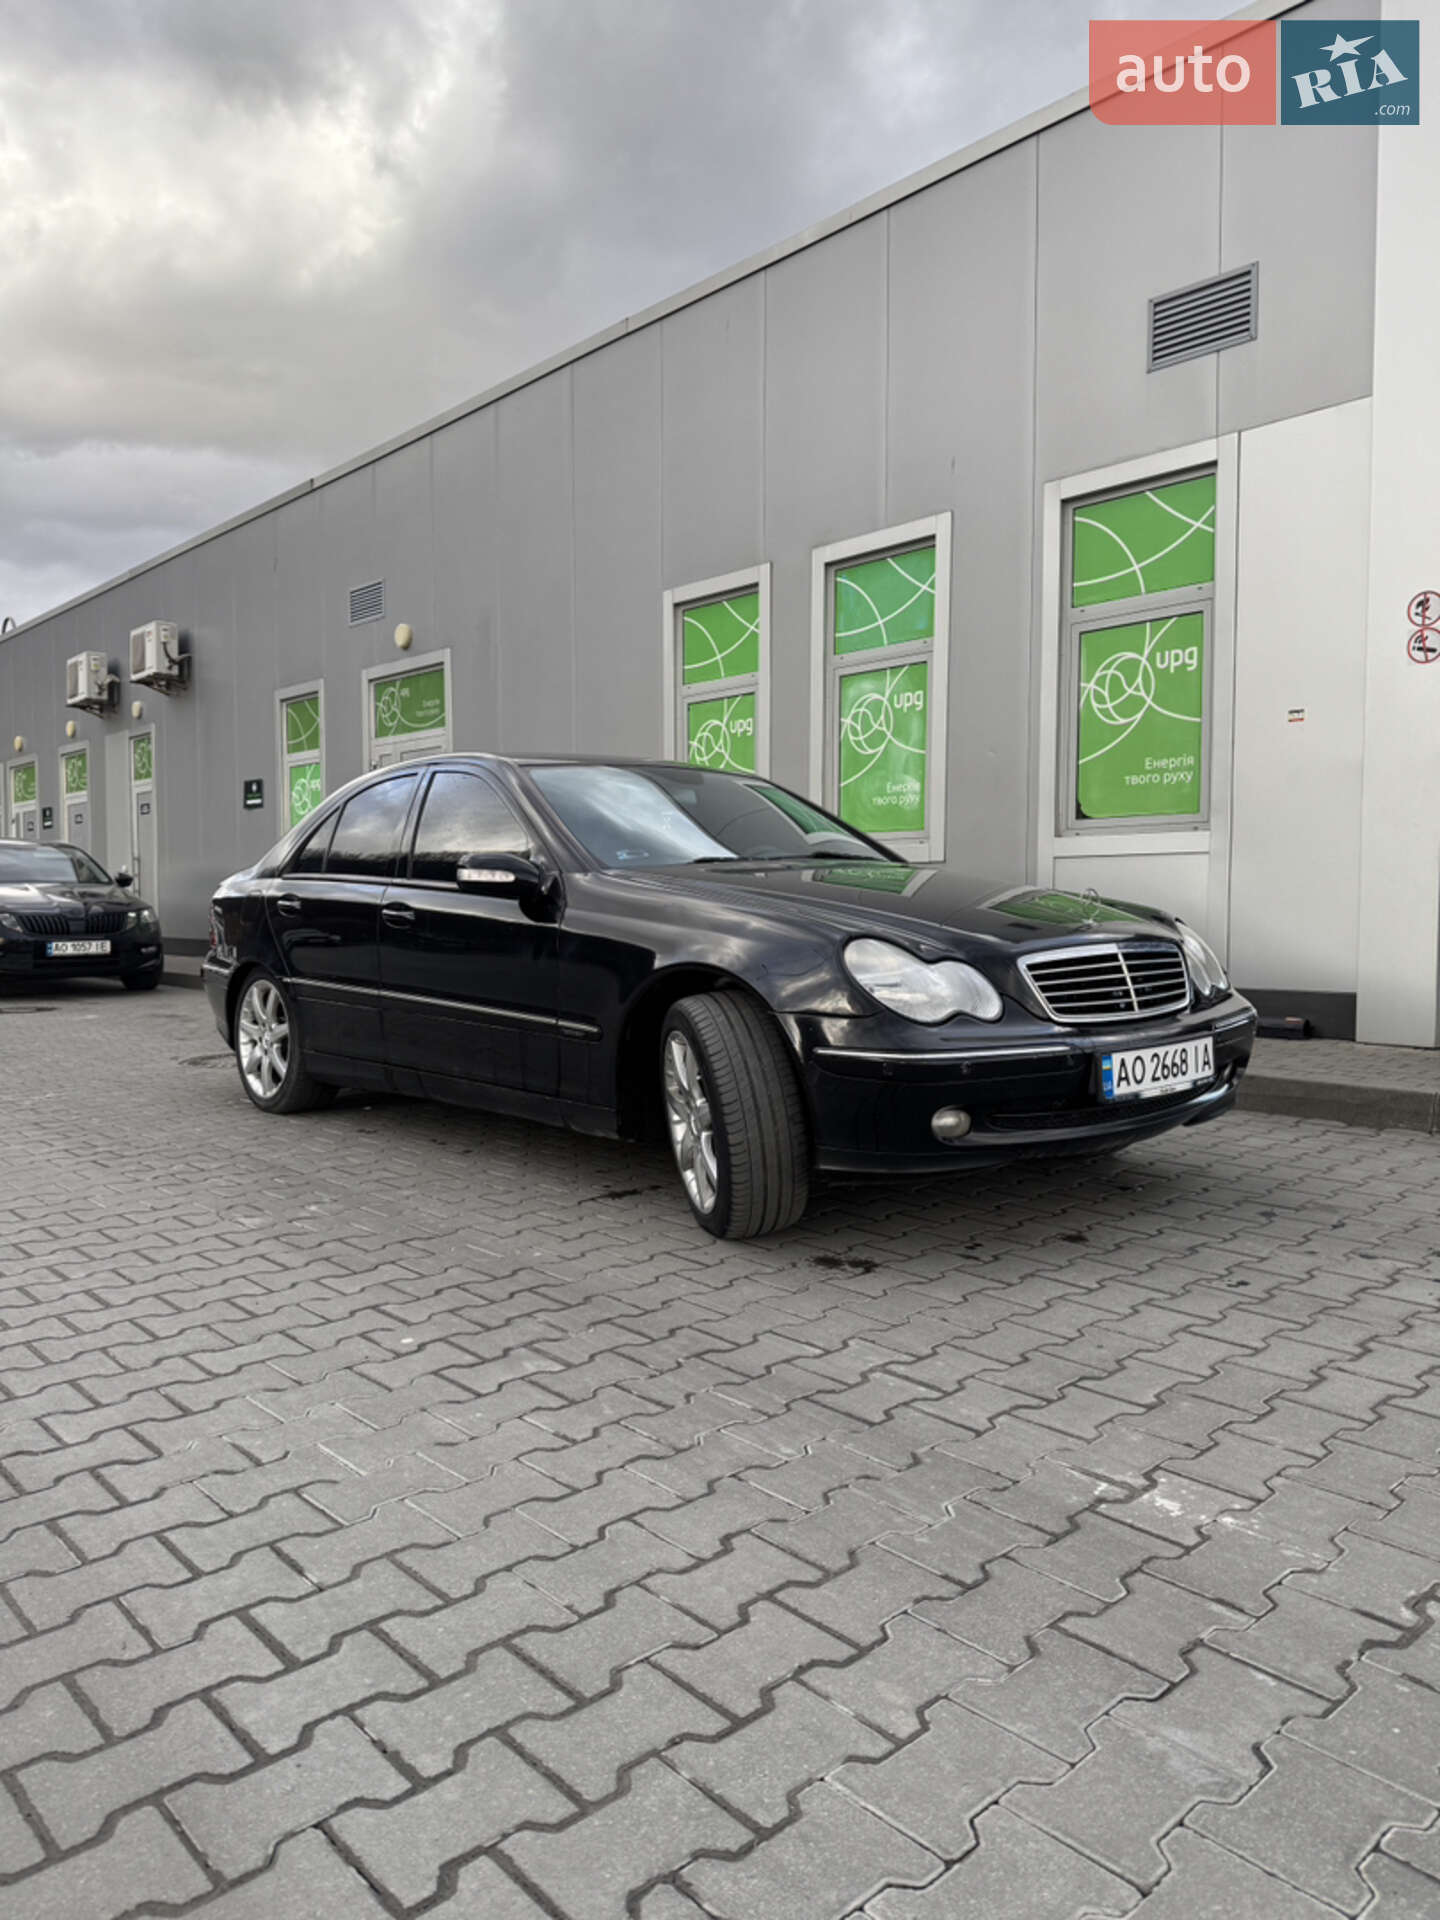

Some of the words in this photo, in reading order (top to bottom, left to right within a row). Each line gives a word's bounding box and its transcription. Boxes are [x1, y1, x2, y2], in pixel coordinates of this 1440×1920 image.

[1156, 646, 1199, 672] upg
[894, 690, 924, 711] upg
[730, 716, 753, 736] upg
[1144, 753, 1194, 770] Енергія
[1124, 773, 1160, 785] твого
[1163, 770, 1194, 785] руху
[1117, 1055, 1146, 1088] AO
[1150, 1047, 1188, 1082] 2668
[1194, 1044, 1212, 1073] IA
